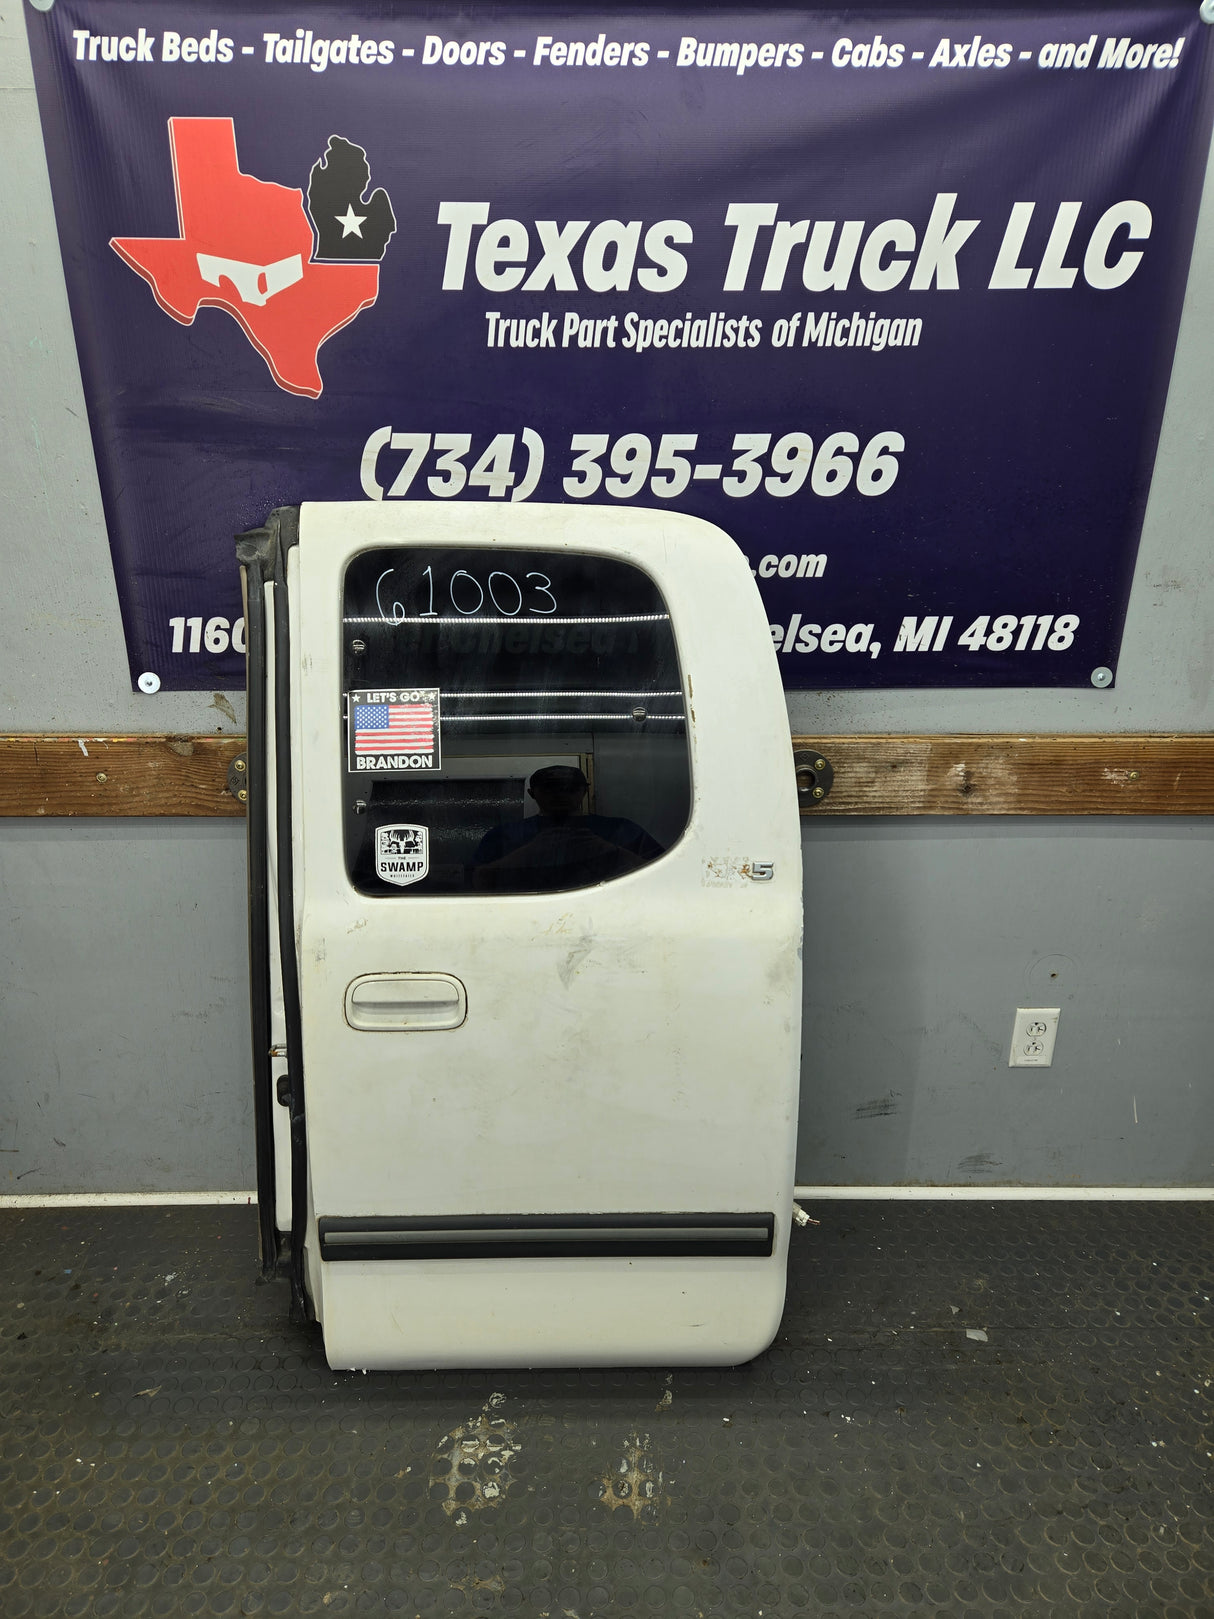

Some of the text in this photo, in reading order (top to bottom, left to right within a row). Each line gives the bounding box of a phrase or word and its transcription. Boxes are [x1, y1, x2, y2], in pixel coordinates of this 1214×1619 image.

[72, 27, 1186, 75] Truck Beds - Tailgates - Doors - Fenders - Bumpers - Cabs - Axles - and More!
[436, 192, 1154, 293] Texas Truck LLC
[485, 311, 923, 353] Truck Part Specialists of Michigan
[359, 425, 906, 502] (734) 395-3966
[376, 566, 557, 626] 61003
[893, 616, 954, 652] MI
[957, 614, 1080, 652] 48118
[366, 691, 420, 703] LET'S GO
[356, 754, 433, 770] BRANDON
[380, 861, 424, 873] SWAMP
